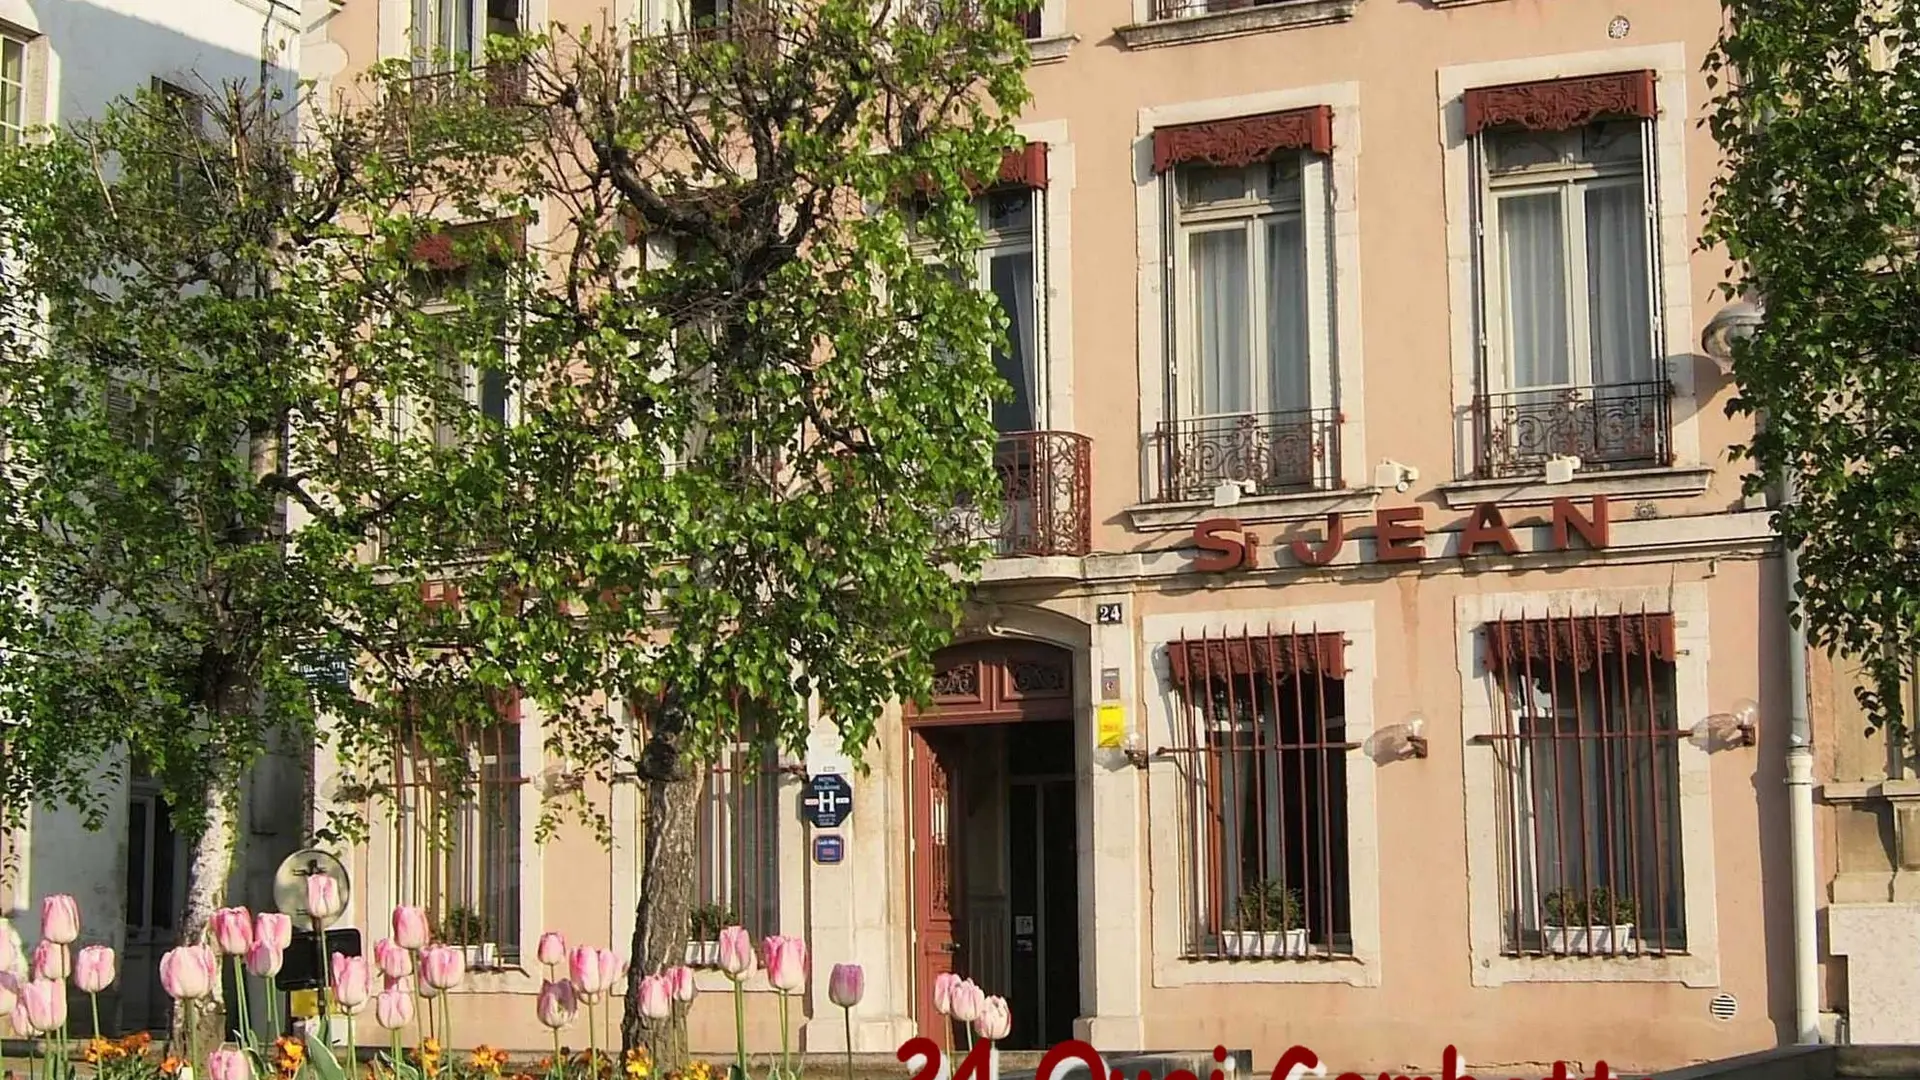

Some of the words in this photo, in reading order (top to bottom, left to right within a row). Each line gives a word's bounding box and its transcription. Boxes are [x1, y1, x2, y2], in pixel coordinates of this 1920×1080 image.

[1290, 494, 1610, 567] JEAN
[1099, 605, 1121, 621] 24
[818, 791, 835, 813] H
